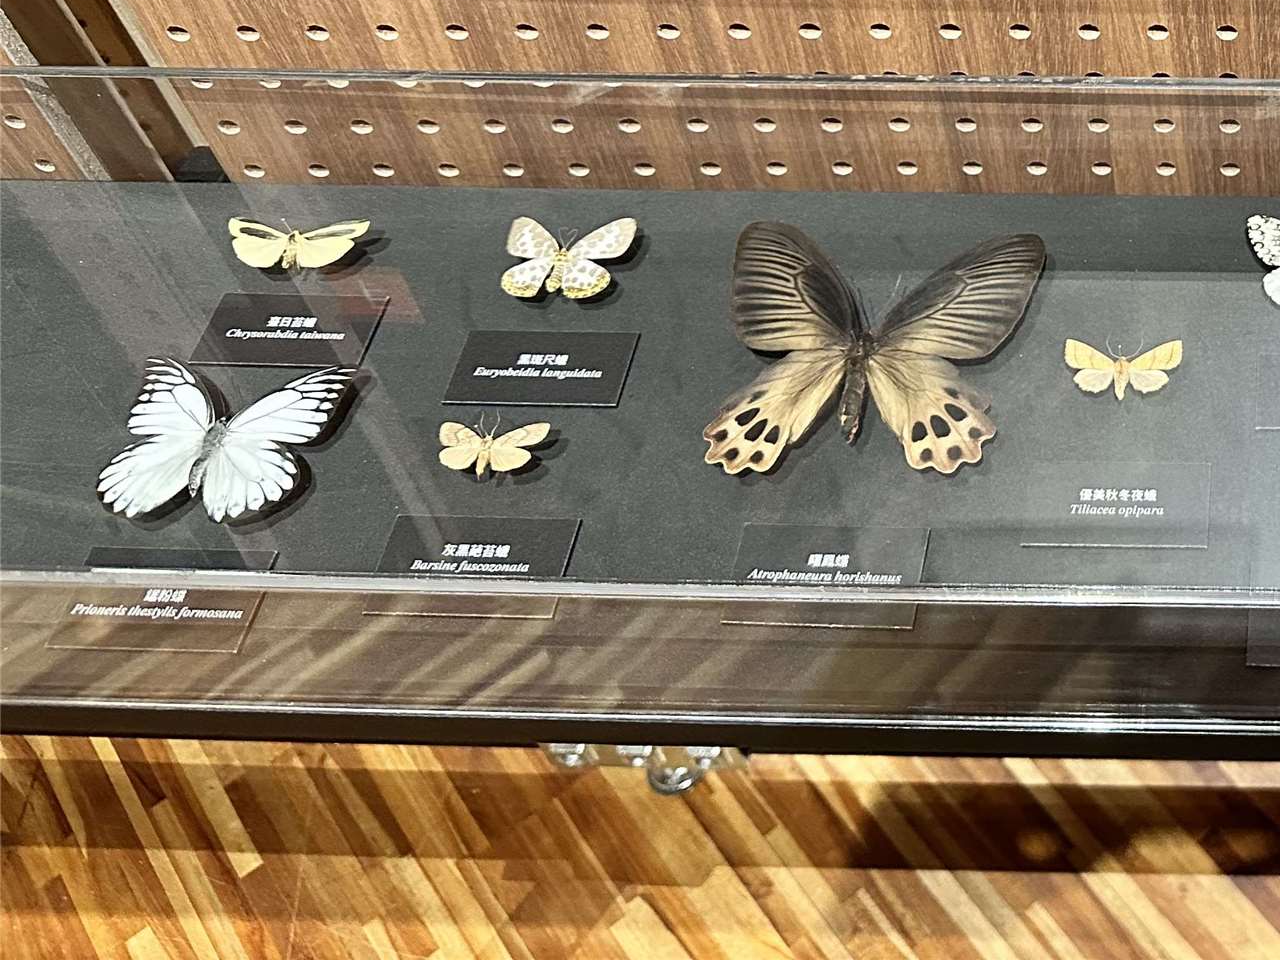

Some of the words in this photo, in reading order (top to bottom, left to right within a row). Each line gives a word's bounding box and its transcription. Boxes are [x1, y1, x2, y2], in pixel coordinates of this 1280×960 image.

[299, 331, 345, 340] taiwana
[541, 368, 602, 380] languidata
[1070, 504, 1117, 515] Tiliacea
[1118, 506, 1164, 518] opipara
[410, 559, 457, 570] Barsine
[455, 560, 530, 573] fuscozonata
[747, 568, 832, 582] Atrophaneura
[833, 570, 902, 582] horishanus
[70, 603, 128, 616] Prioneris
[127, 604, 177, 618] thestylis
[174, 606, 244, 620] formosana
